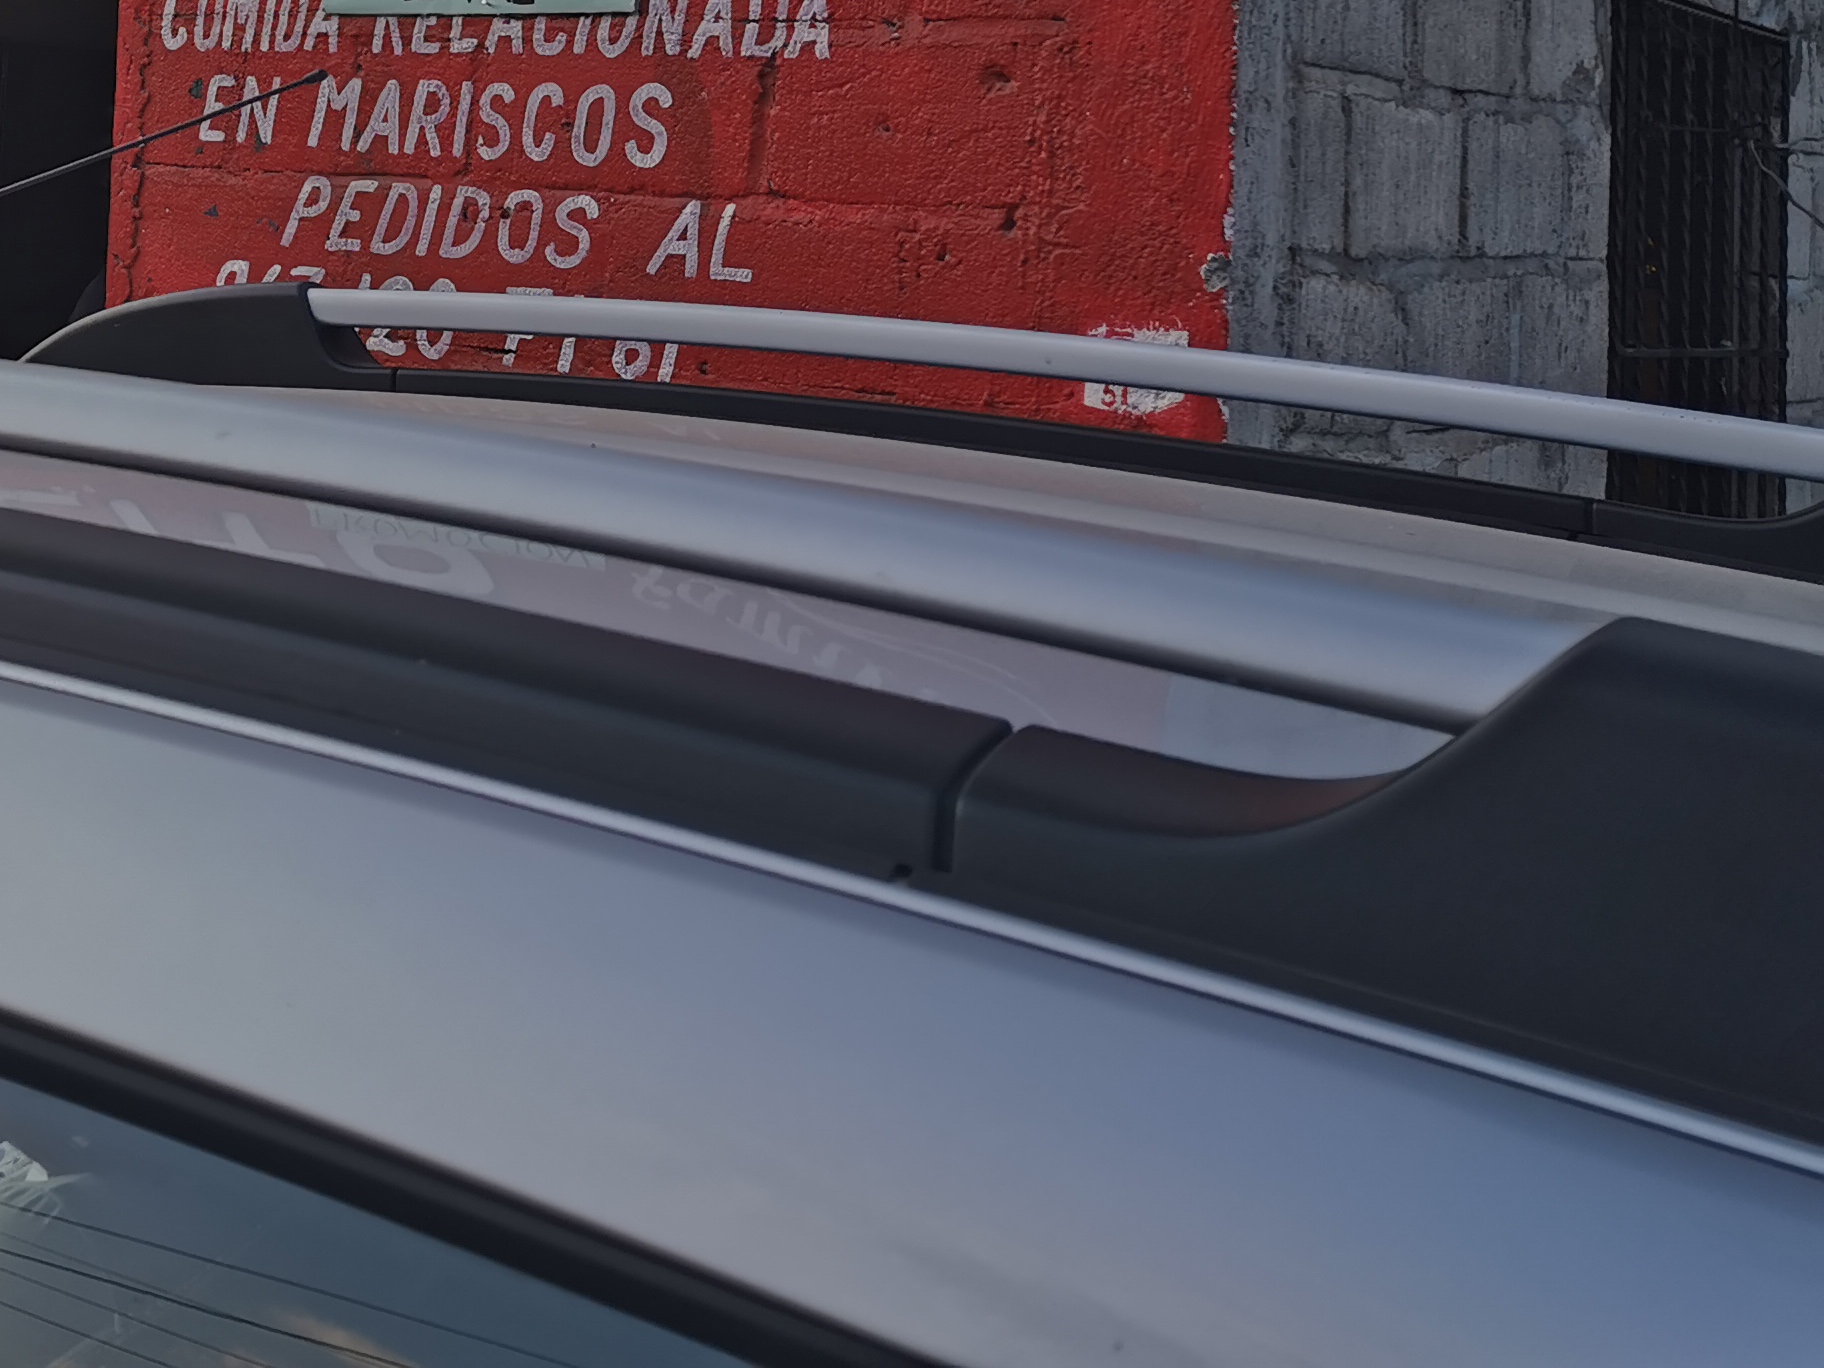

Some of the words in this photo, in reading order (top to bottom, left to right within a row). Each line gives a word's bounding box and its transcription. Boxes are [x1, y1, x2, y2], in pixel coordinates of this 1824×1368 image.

[198, 74, 281, 145] EN
[307, 76, 674, 169] MARISCOS
[280, 175, 600, 270] PEDIDOS
[647, 199, 753, 282] AL
